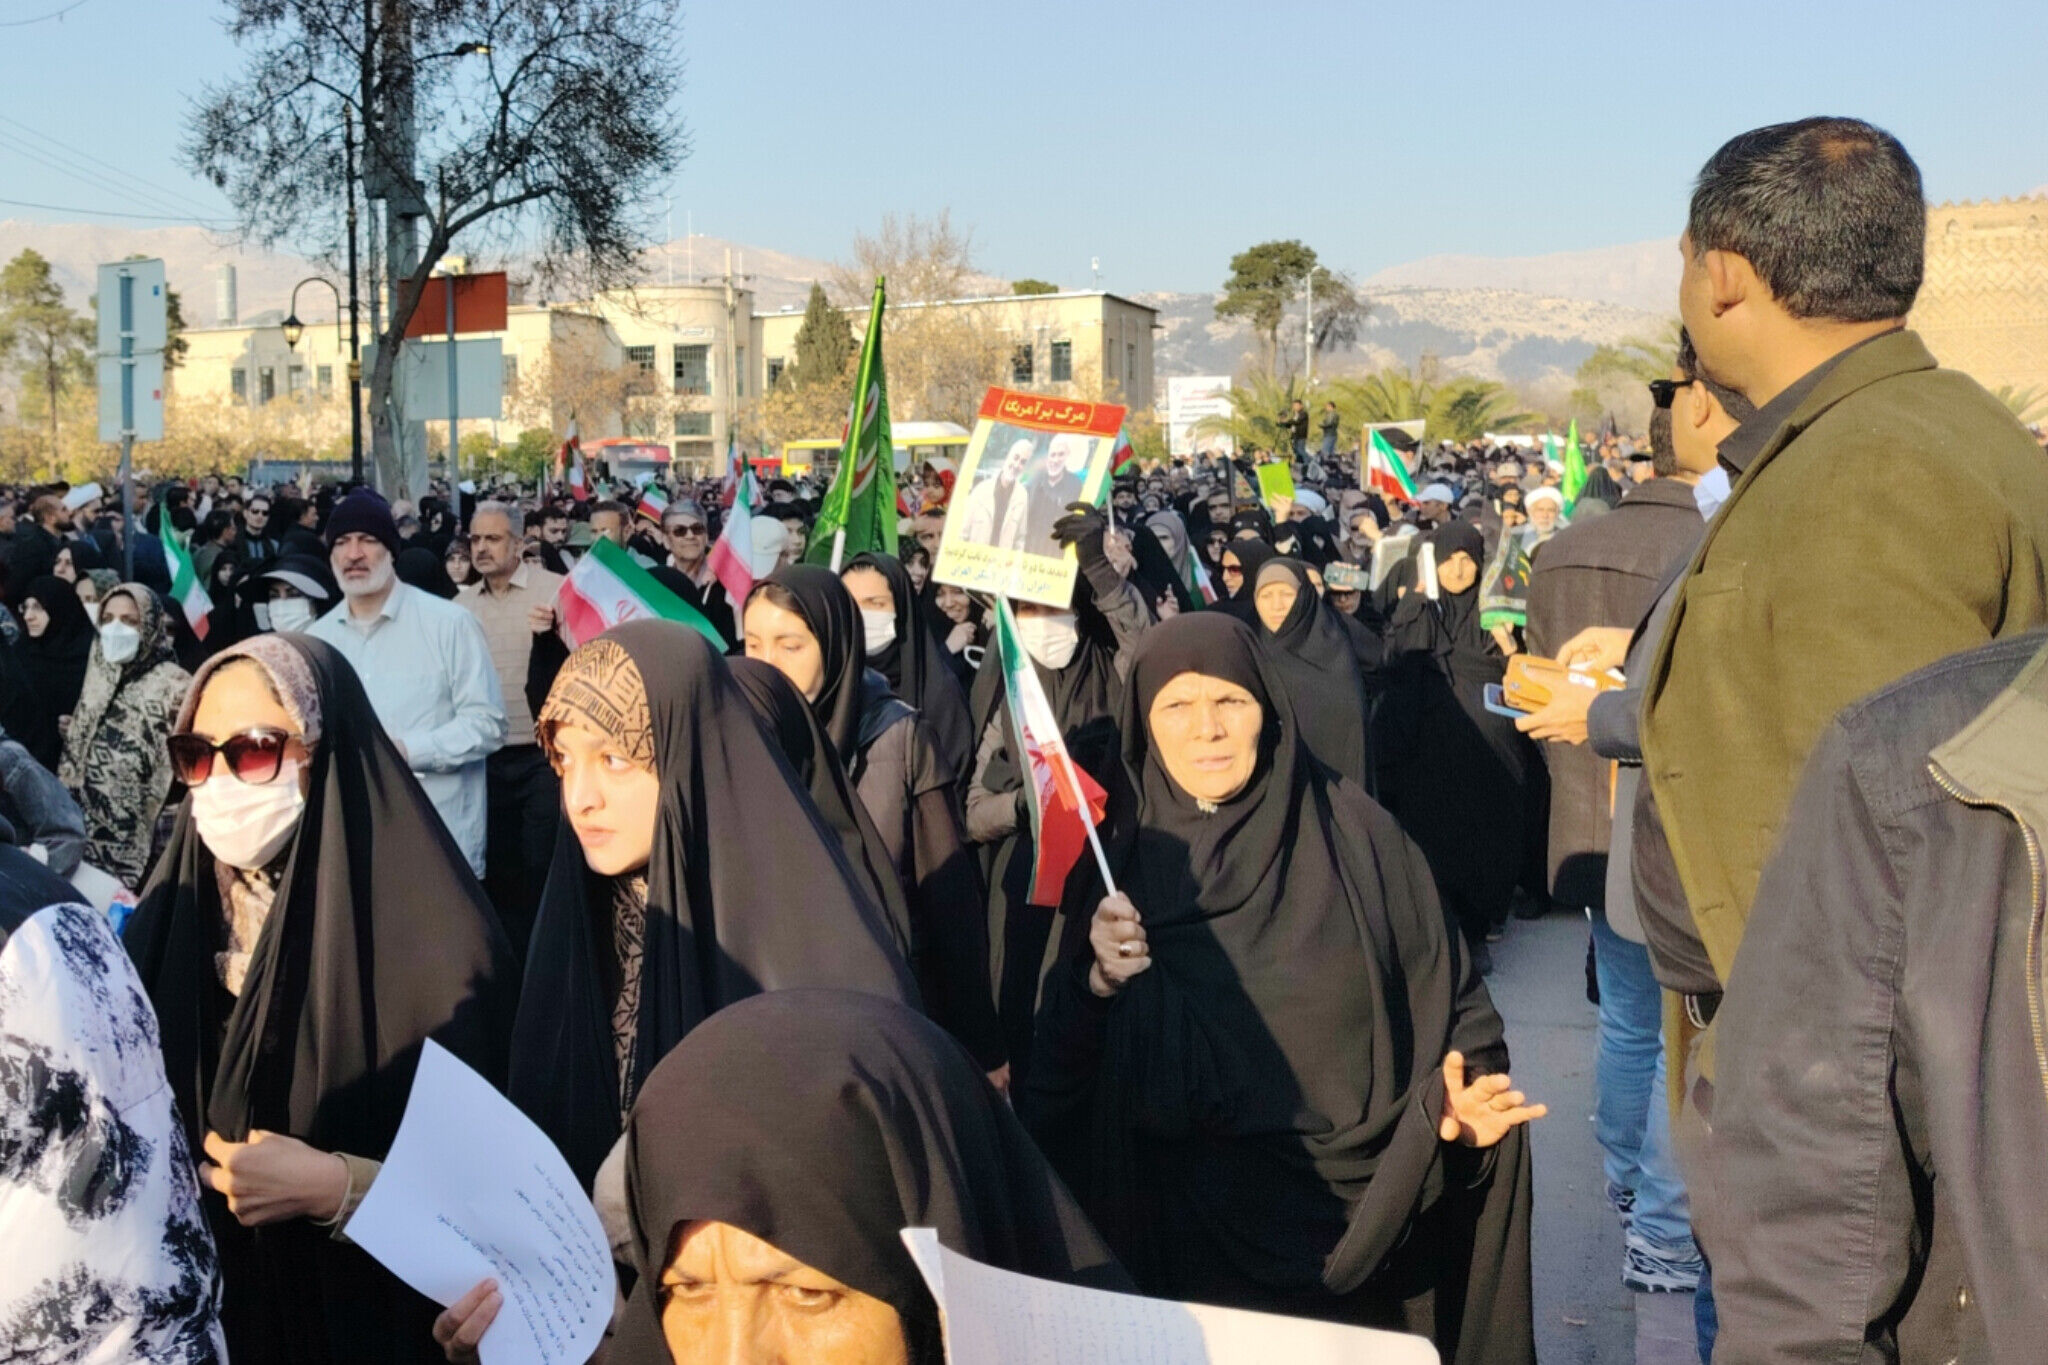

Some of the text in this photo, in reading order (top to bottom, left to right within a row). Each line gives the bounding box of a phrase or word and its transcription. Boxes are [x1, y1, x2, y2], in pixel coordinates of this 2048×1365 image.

[1004, 400, 1086, 424] مرگ بر آمریکا
